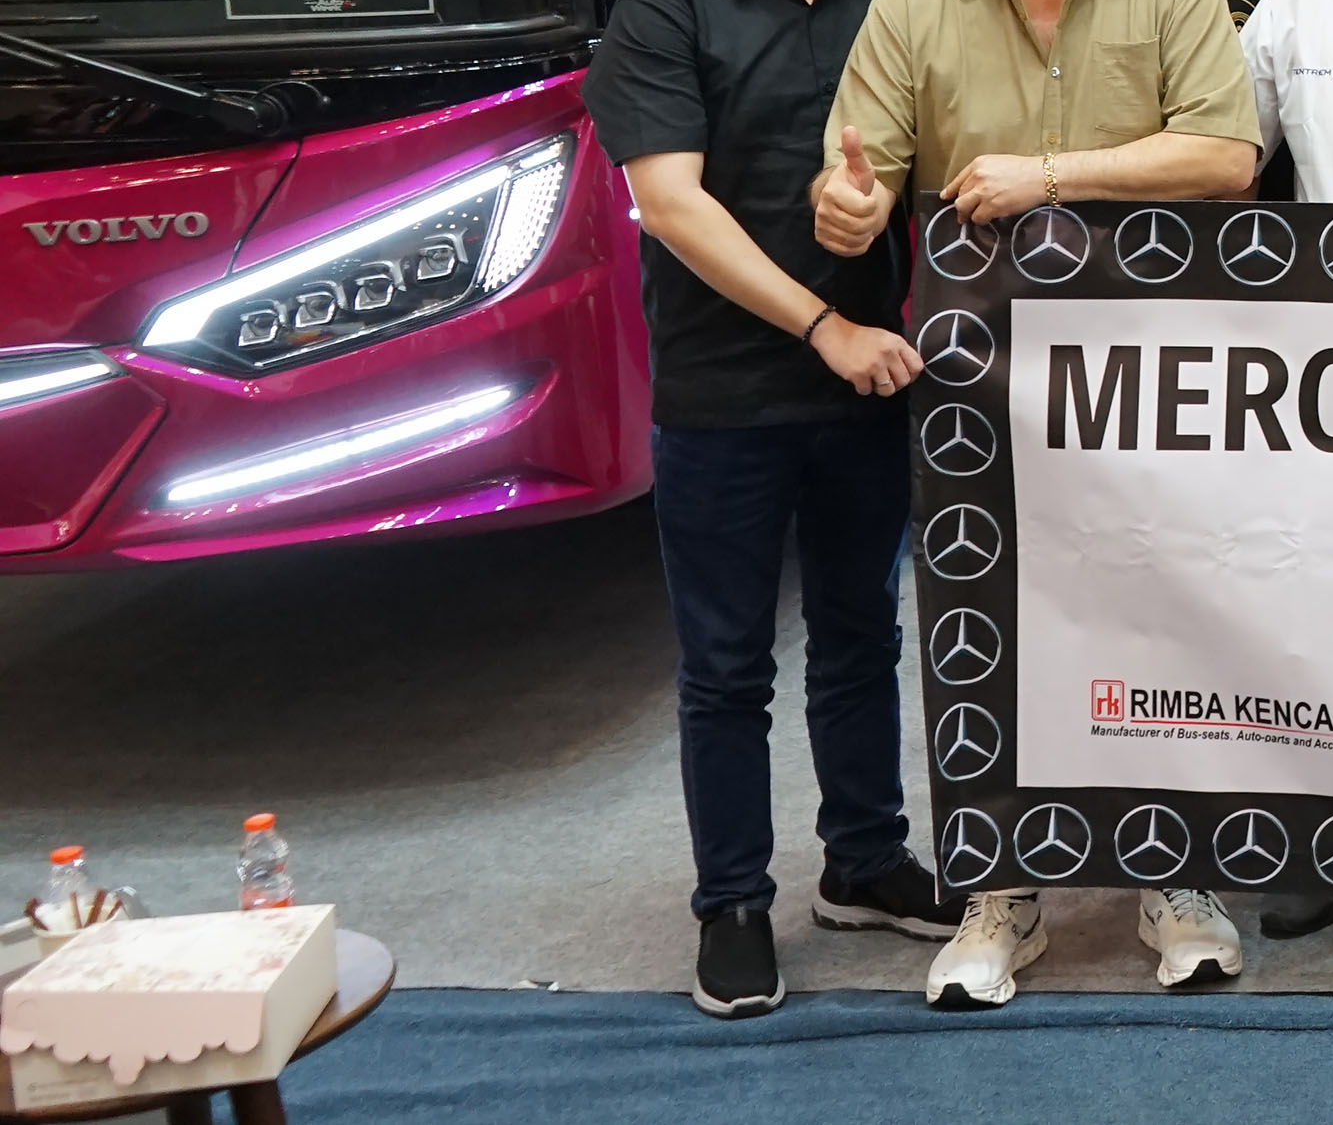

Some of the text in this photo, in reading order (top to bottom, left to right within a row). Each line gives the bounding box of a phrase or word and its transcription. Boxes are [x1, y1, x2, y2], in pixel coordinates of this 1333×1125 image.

[22, 211, 209, 246] VOLVO
[1131, 689, 1226, 721] RIMBA
[1090, 725, 1161, 739] Manufacturer
[1163, 727, 1176, 739] of
[1236, 730, 1290, 746] Auto-parts
[1293, 737, 1312, 748] and
